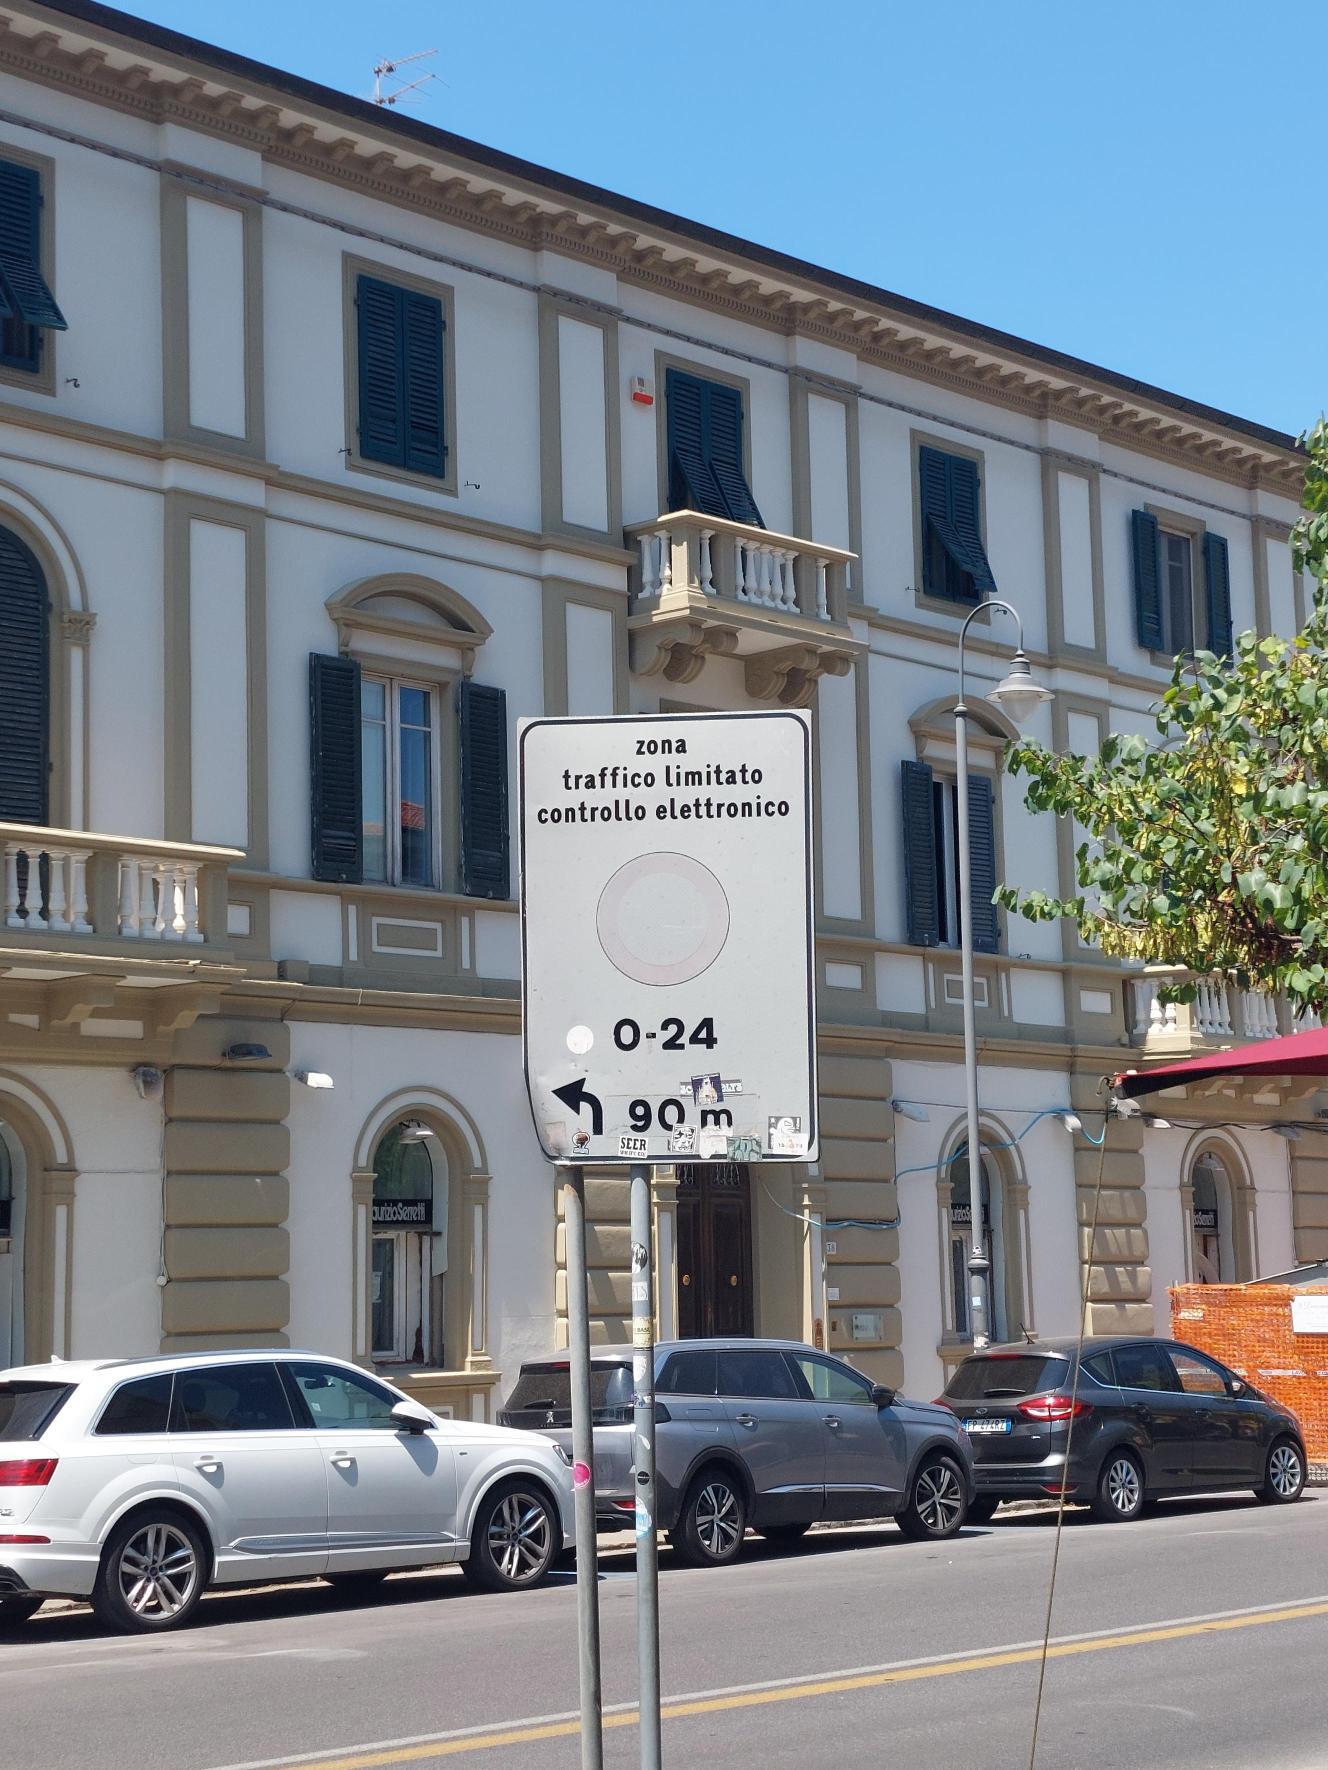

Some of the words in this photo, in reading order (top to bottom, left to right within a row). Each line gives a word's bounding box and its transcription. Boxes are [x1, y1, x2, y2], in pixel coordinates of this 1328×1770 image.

[636, 738, 688, 756] zona
[562, 766, 656, 790] traffico
[665, 763, 763, 787] limitato
[537, 799, 647, 824] controllo
[656, 795, 790, 820] elettronico
[613, 1017, 718, 1052] 0-24
[628, 1098, 686, 1133] 90
[700, 1107, 733, 1129] m
[620, 1136, 647, 1151] SEER
